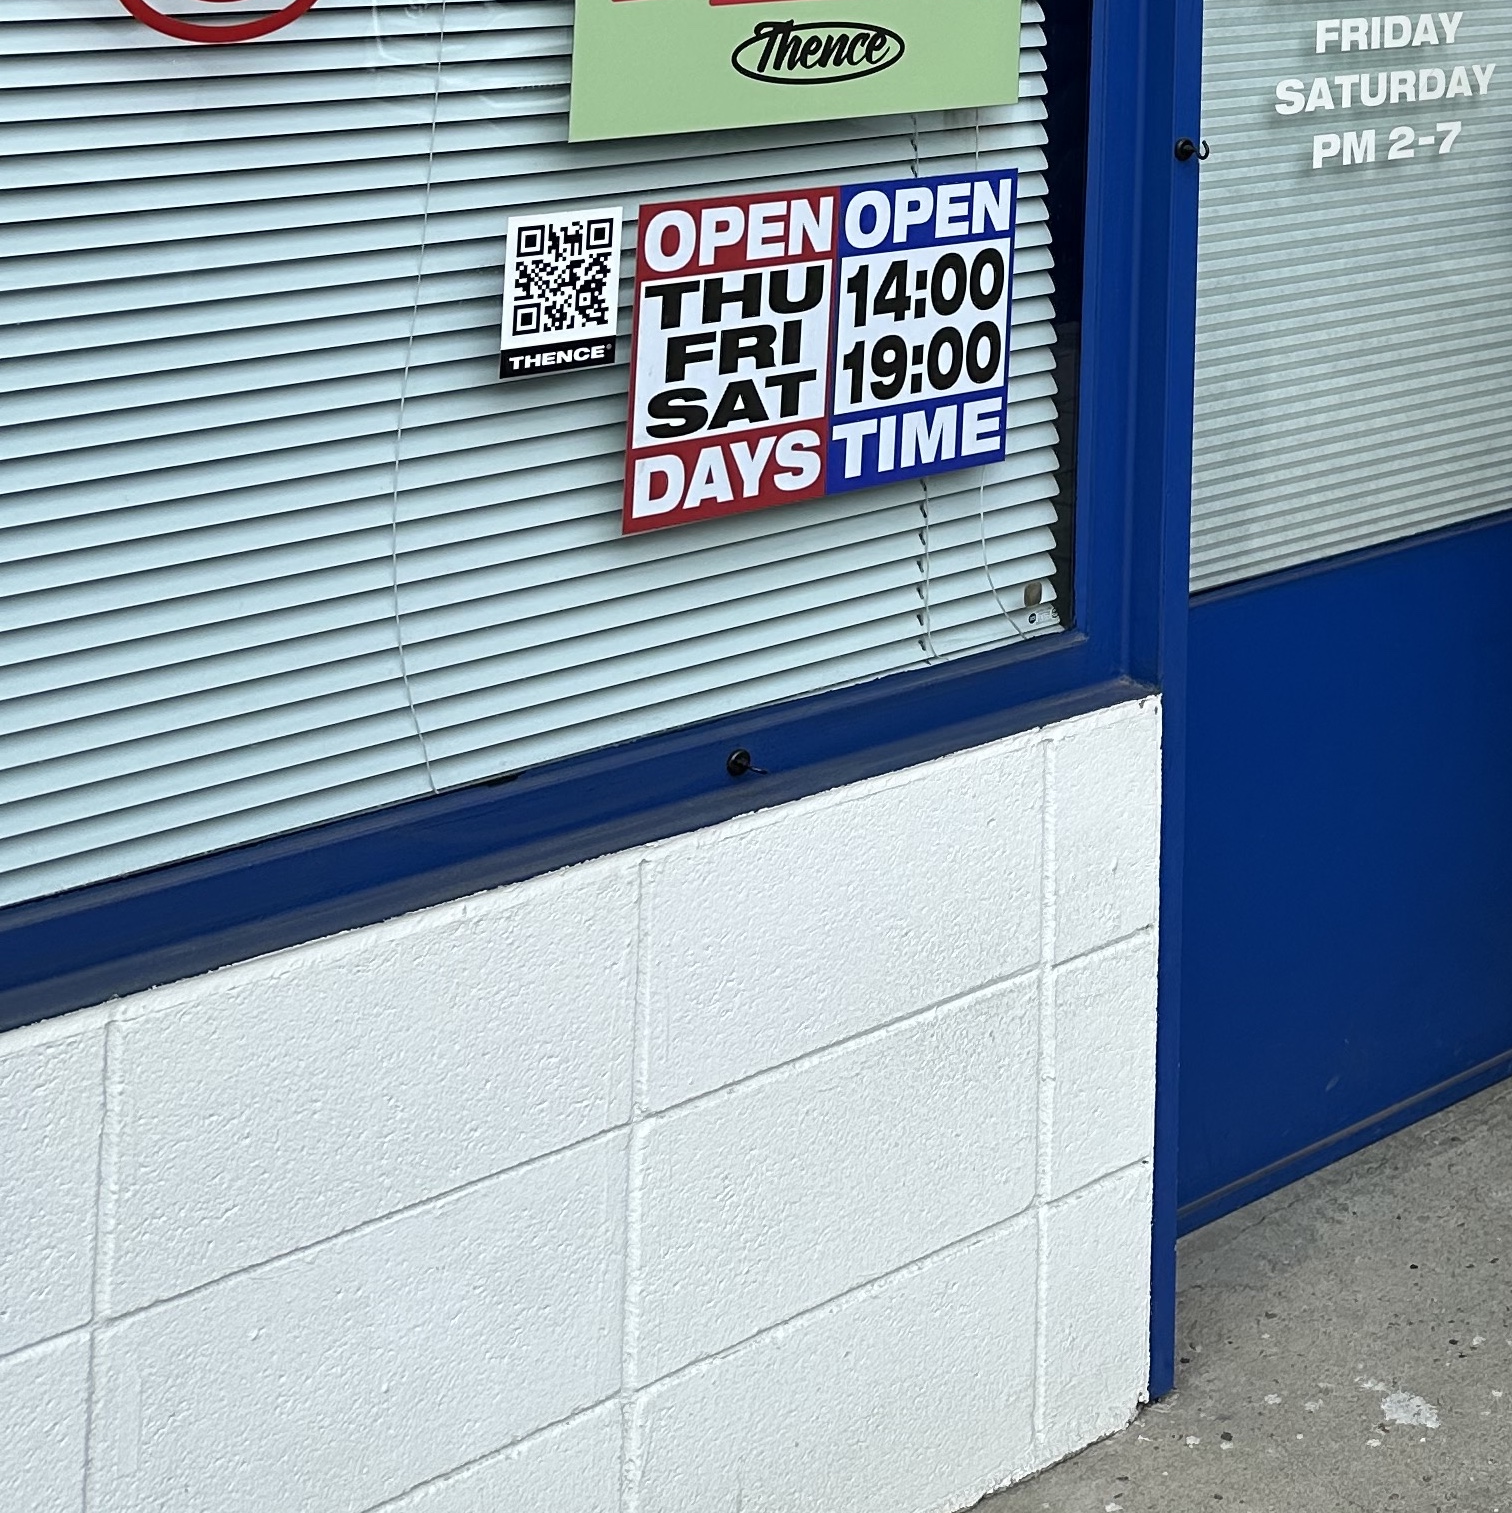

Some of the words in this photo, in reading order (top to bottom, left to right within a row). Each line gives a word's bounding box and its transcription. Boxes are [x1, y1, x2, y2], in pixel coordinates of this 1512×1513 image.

[754, 19, 891, 73] Thence
[1315, 12, 1464, 54] FRIDAY
[1275, 63, 1497, 116] SATURDAY
[1312, 129, 1376, 170] PM
[1387, 121, 1463, 162] 2-7
[644, 196, 834, 273] OPEN
[844, 178, 1012, 249] OPEN
[644, 264, 825, 329] THU
[846, 247, 1005, 328] 14:00
[665, 318, 802, 384] FRI
[842, 320, 1001, 404] 19:00
[645, 369, 817, 439] SAT
[832, 396, 1003, 479] TIME
[631, 428, 821, 519] DAYS
